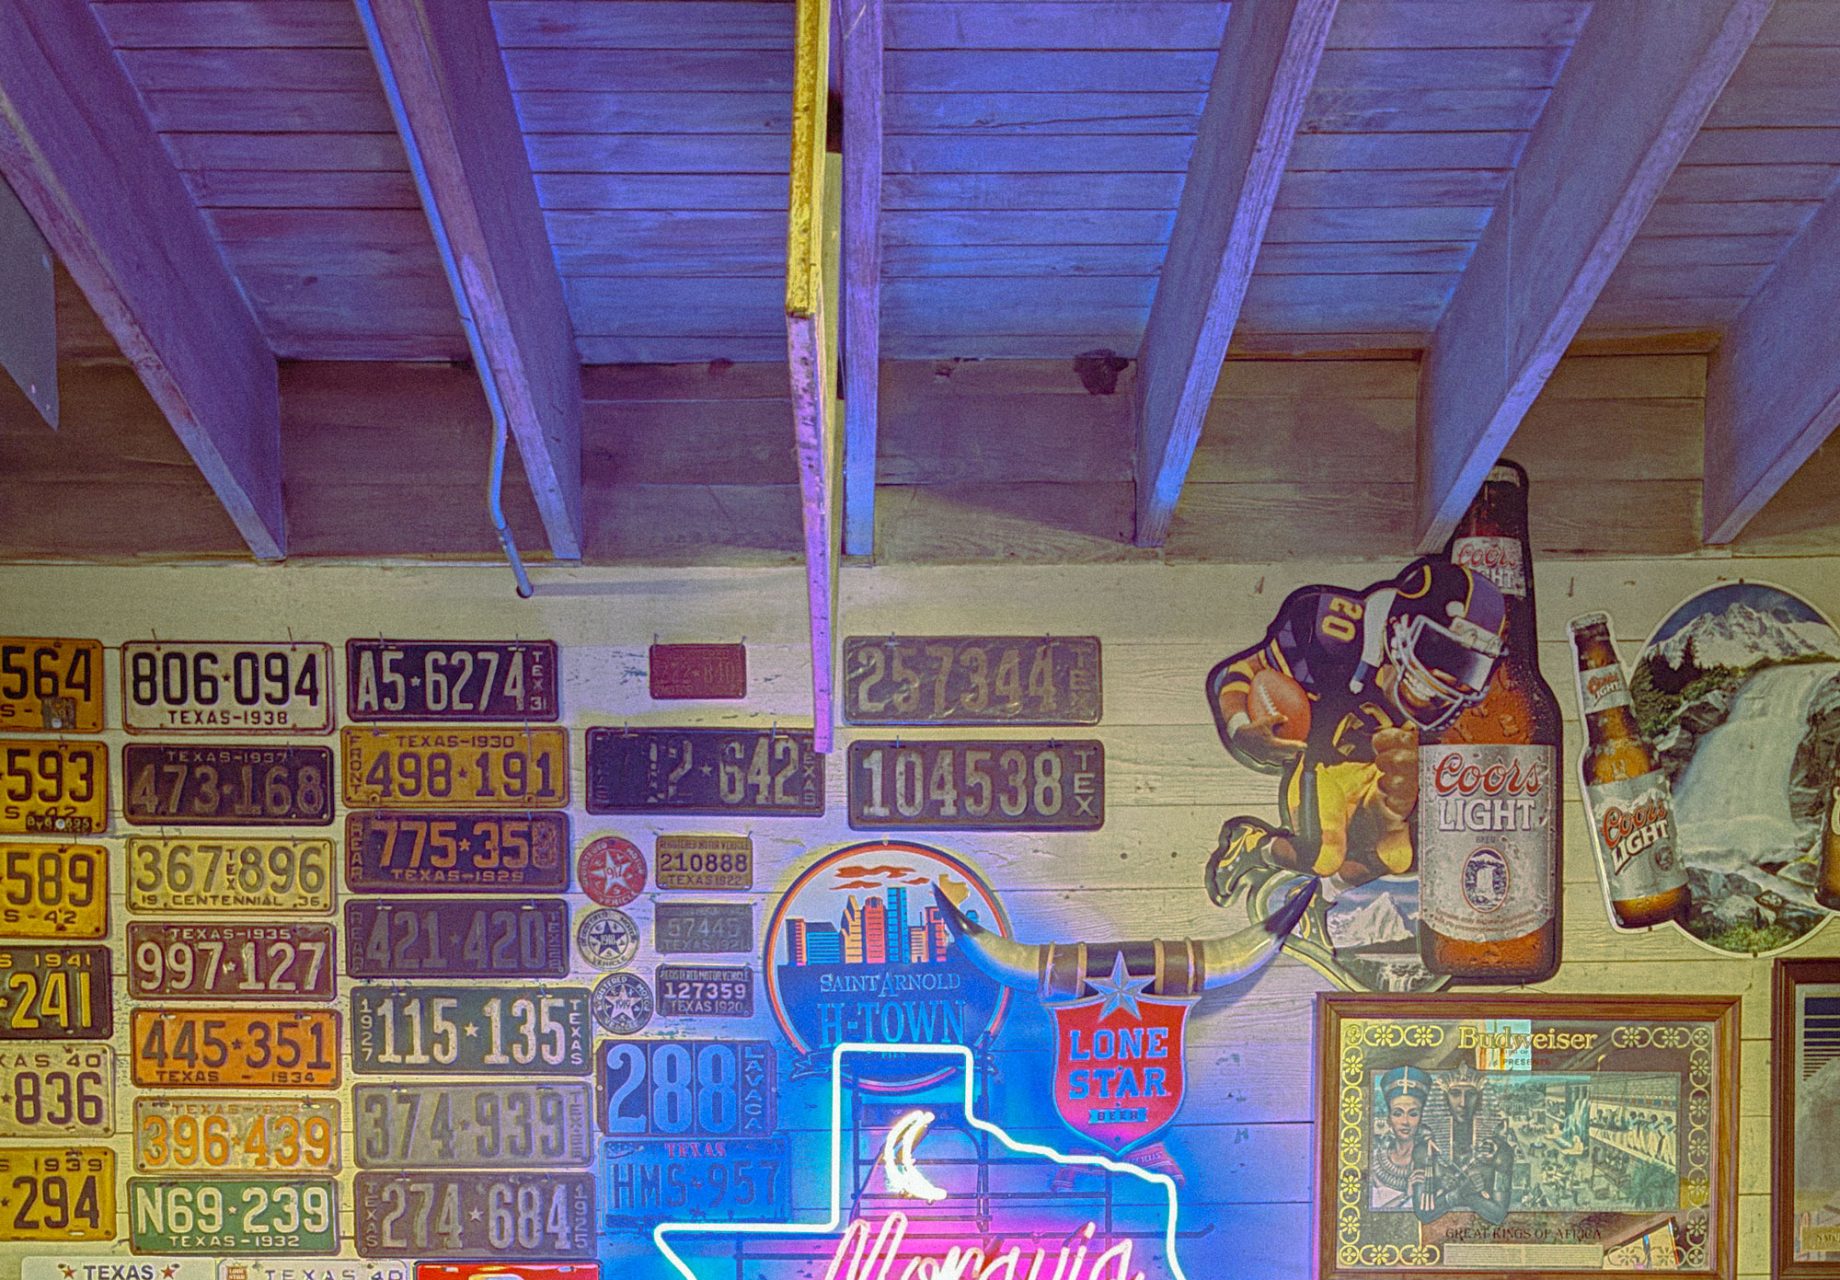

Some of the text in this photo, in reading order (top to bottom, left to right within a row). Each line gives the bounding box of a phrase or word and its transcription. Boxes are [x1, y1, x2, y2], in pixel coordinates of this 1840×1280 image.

[2, 645, 91, 702] 564
[132, 651, 318, 706] 806 094
[358, 651, 526, 712] A5 6274
[7, 748, 94, 803] 593
[366, 751, 556, 797] 498 191
[862, 750, 1095, 817] 104538 TEX
[1434, 752, 1542, 798] Coors
[1438, 799, 1536, 833] LIGHT
[1602, 798, 1669, 849] Coors
[371, 821, 457, 868] 775
[661, 851, 748, 873] 210888
[1610, 819, 1670, 875] LIGHT
[6, 852, 94, 907] 589
[136, 846, 222, 892] 367
[238, 846, 325, 893] 896
[172, 895, 283, 907] CENTENNIAL
[35, 953, 91, 968] 1941
[367, 911, 448, 969] 421
[463, 911, 546, 969] 420
[136, 941, 325, 990] 997 127
[879, 972, 961, 998] ARNOLD
[10, 971, 91, 1029] 241
[664, 982, 747, 1000] 127359
[141, 1020, 332, 1069] 445 351
[377, 999, 458, 1065] 115
[483, 998, 566, 1065] 135
[569, 999, 583, 1065] TEXAS
[817, 1000, 966, 1049] H-TOWN
[1069, 1028, 1169, 1061] LONE
[1457, 1026, 1598, 1050] Budweiser
[14, 1071, 103, 1126] 836
[606, 1043, 737, 1133] 288
[1069, 1070, 1168, 1100] STAR
[142, 1115, 331, 1166] 396 439
[364, 1093, 456, 1159] 374
[474, 1092, 567, 1159] 939
[664, 1142, 726, 1158] TEXAS
[12, 1176, 99, 1229] 294
[612, 1159, 781, 1208] HMS 957
[138, 1187, 328, 1234] N69 239
[381, 1183, 463, 1248] 274
[488, 1184, 571, 1249] 684
[1492, 1227, 1531, 1240] KINGS
[84, 1264, 154, 1280] TEXAS
